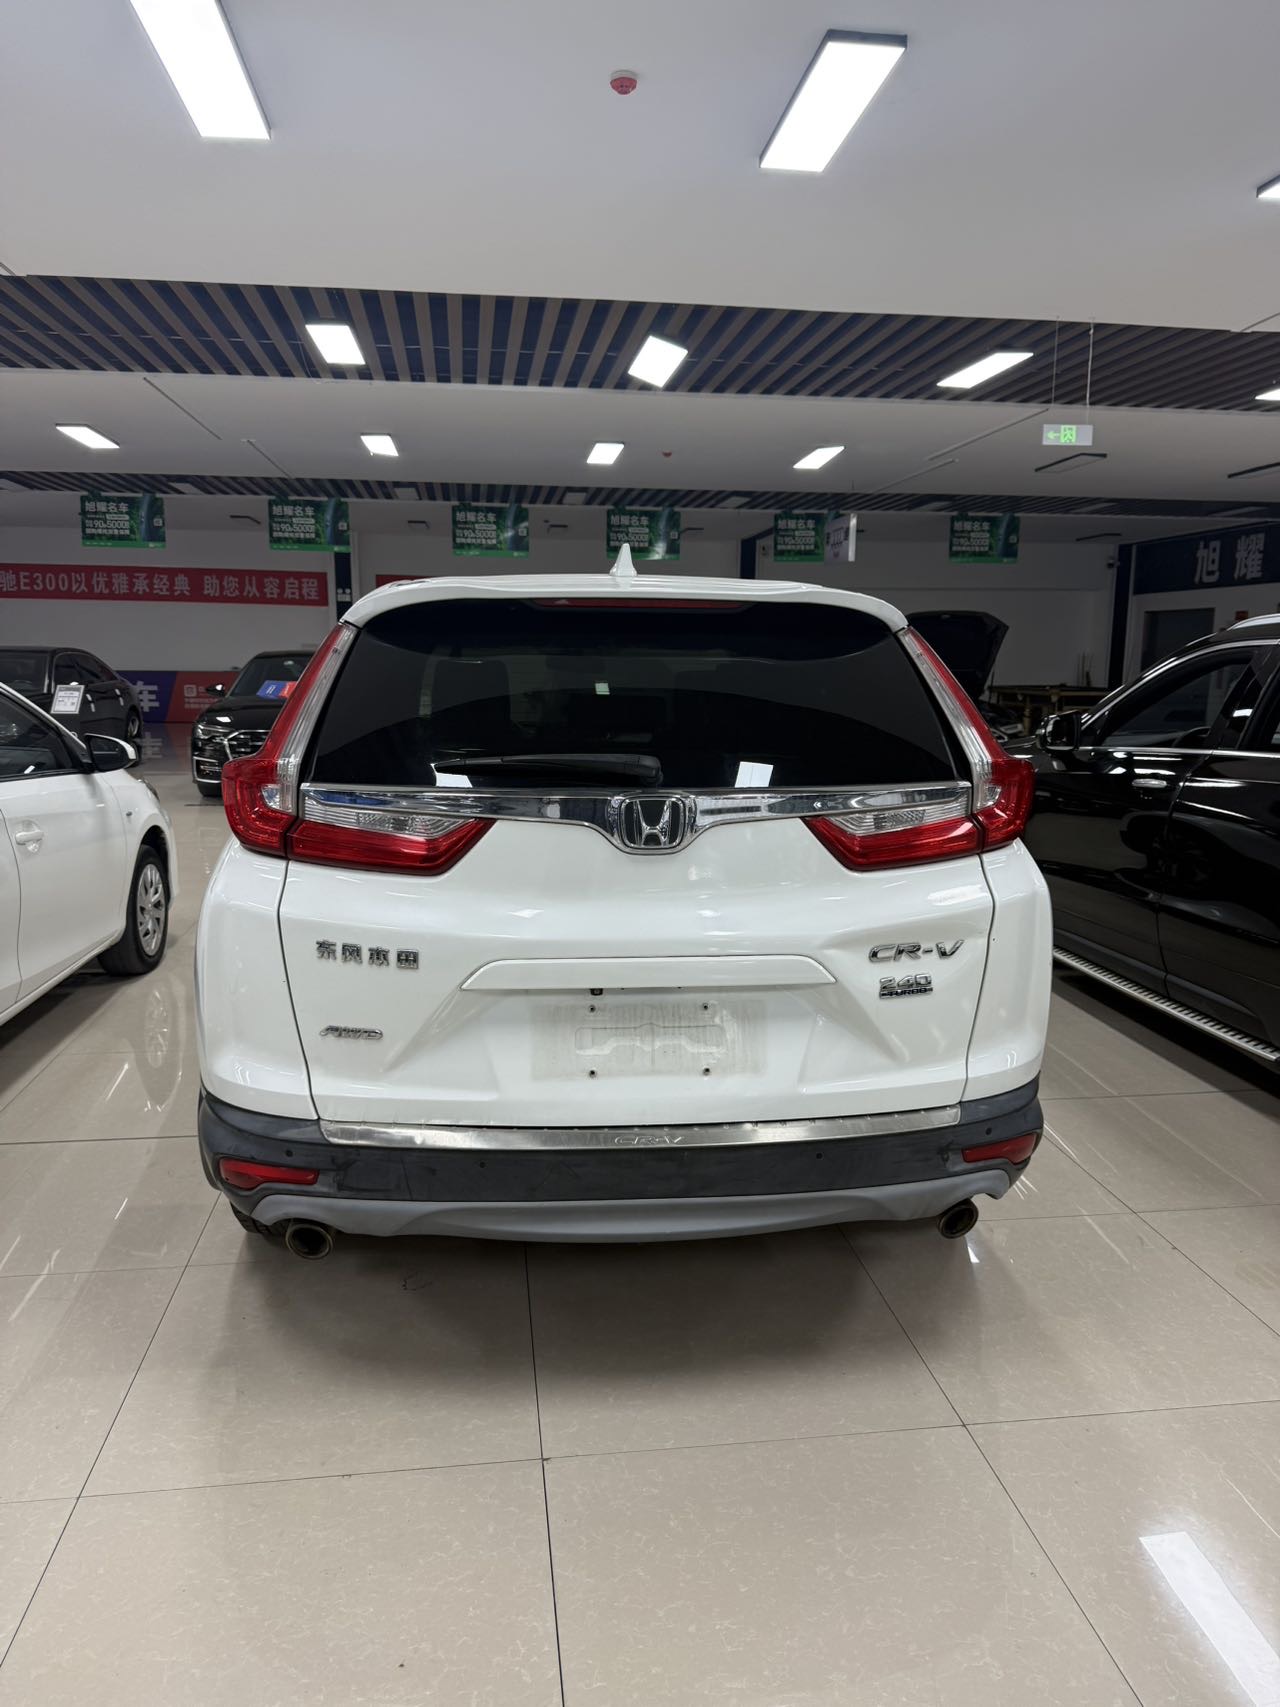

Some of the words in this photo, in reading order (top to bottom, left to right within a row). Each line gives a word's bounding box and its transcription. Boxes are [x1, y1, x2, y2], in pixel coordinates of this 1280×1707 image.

[203, 574, 320, 601] 助您从容启程
[315, 939, 419, 970] 东风本田
[868, 939, 965, 962] CR-V
[880, 973, 932, 991] 240
[884, 987, 931, 998] TURBO
